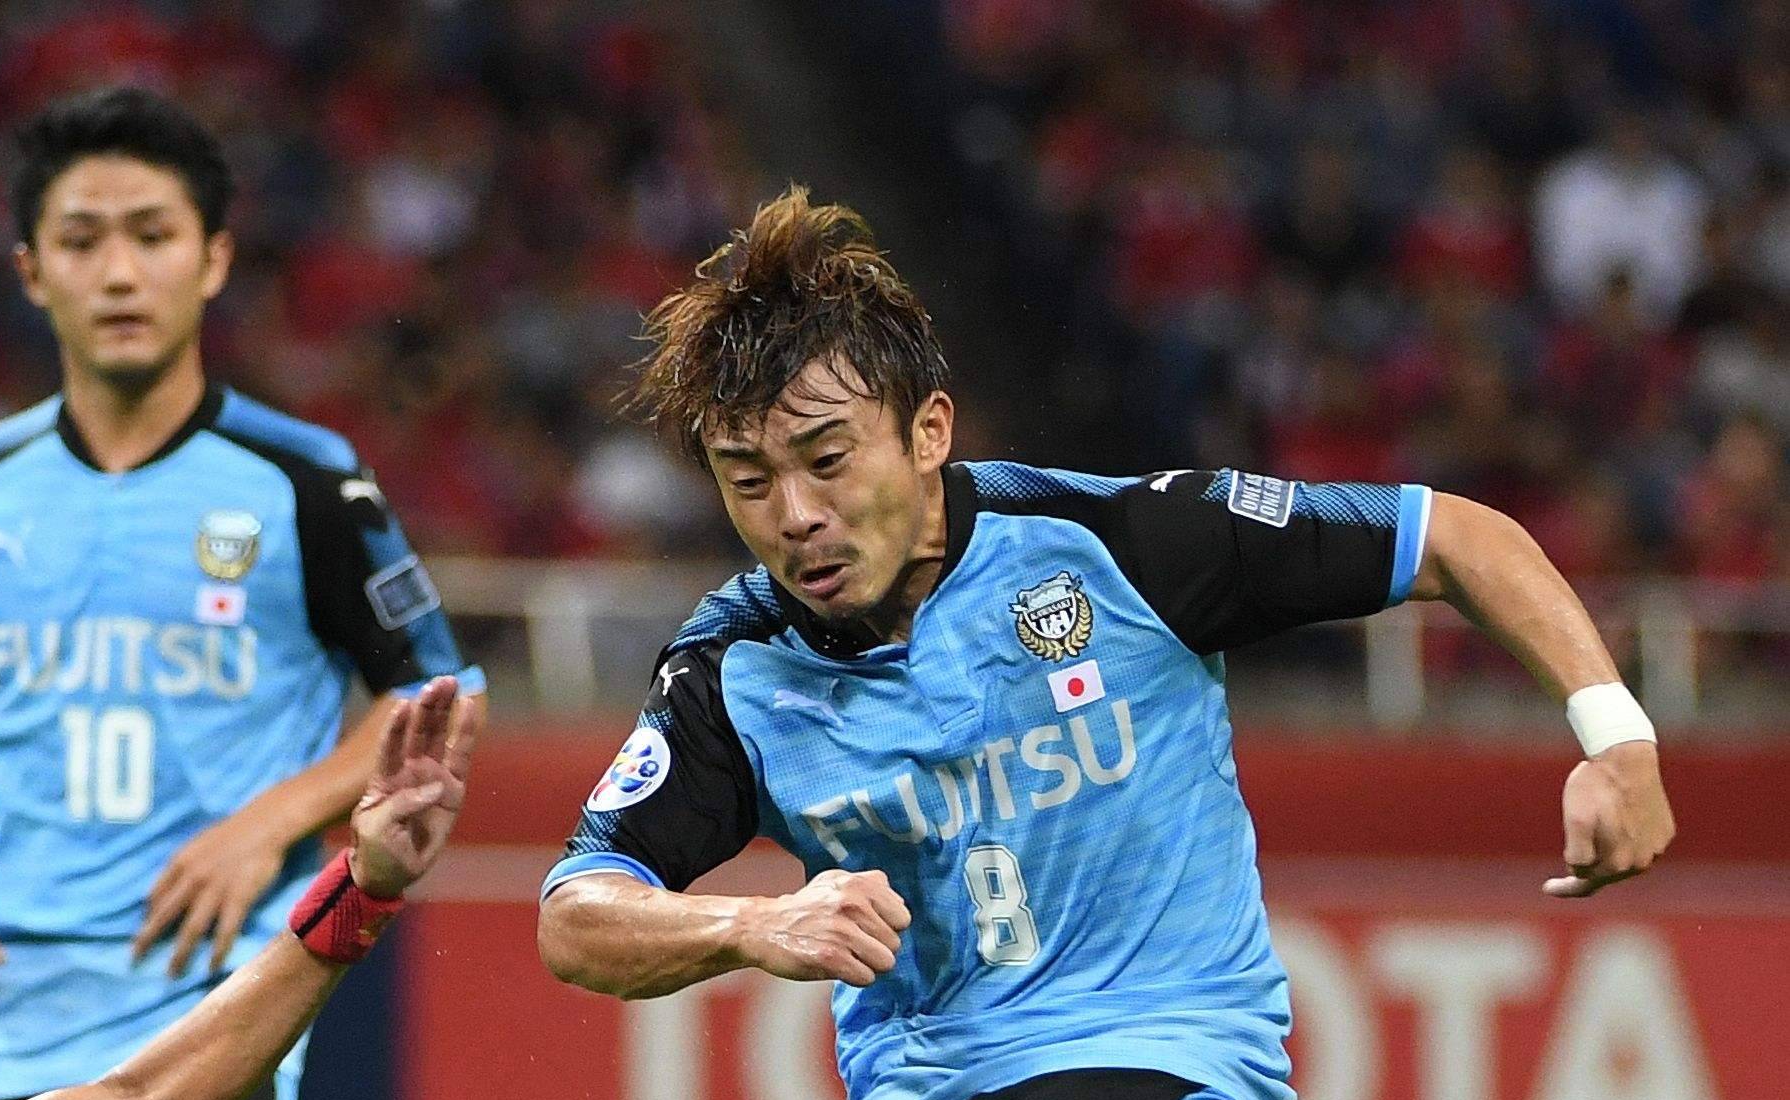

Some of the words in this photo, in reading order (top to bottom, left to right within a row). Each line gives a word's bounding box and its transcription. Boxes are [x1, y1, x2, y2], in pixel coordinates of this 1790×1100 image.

[63, 703, 154, 824] 10
[802, 698, 1137, 864] FUJITSU
[964, 844, 1041, 967] 8
